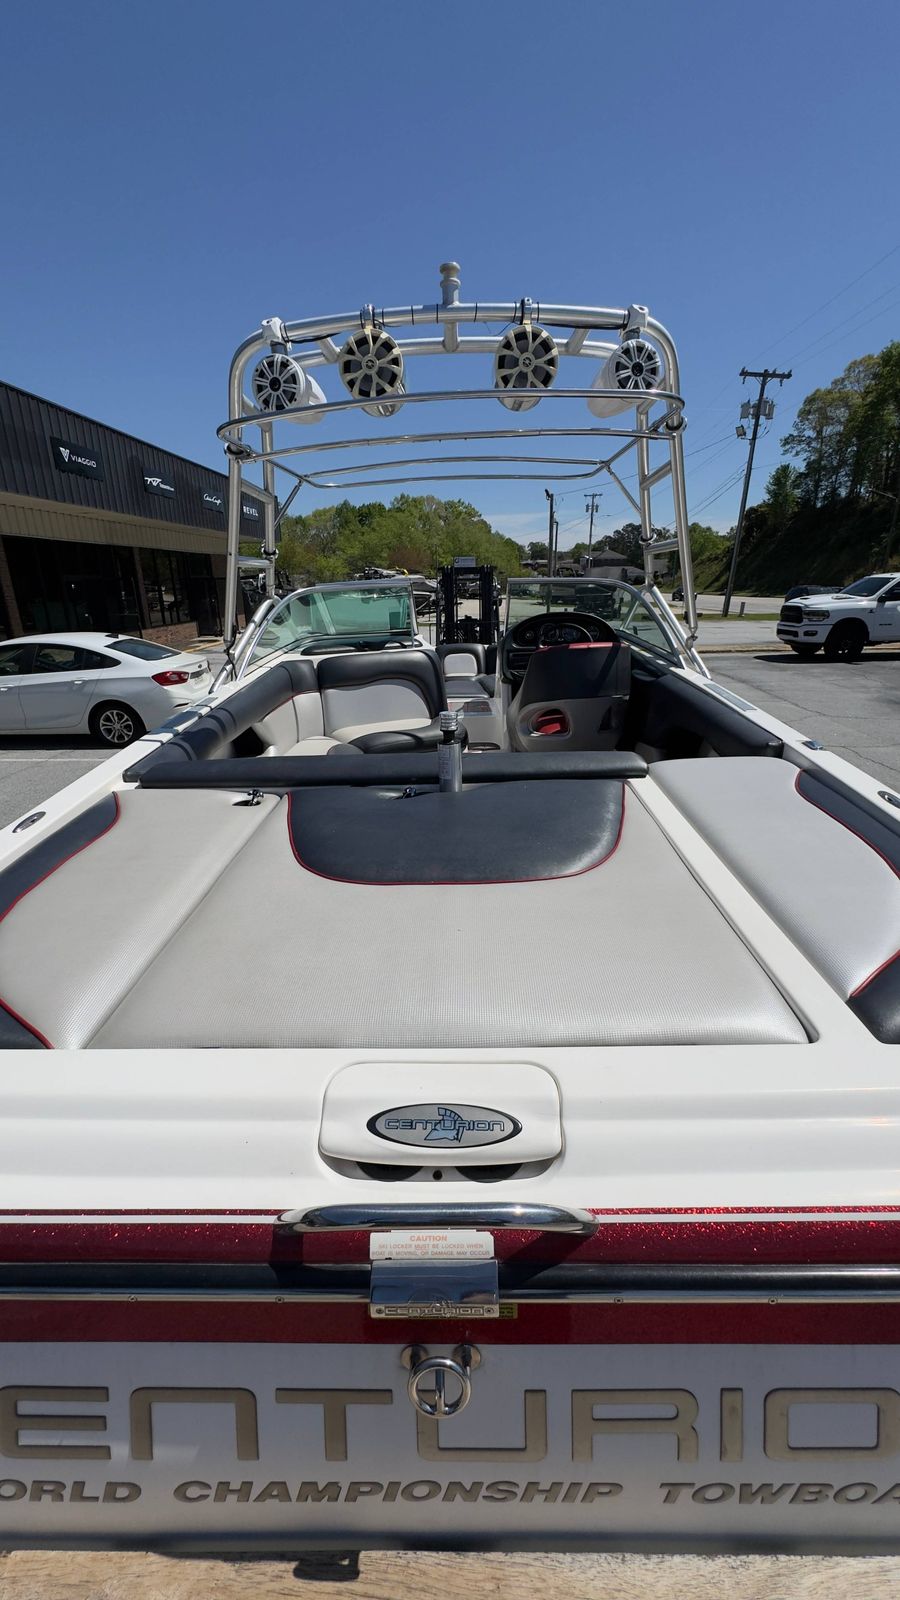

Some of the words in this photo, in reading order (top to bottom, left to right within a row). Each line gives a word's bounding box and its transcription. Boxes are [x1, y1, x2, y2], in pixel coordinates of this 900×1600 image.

[70, 455, 97, 468] VIAGGIO
[243, 505, 259, 517] REVEL
[385, 1119, 505, 1131] CENTURION
[409, 1234, 448, 1242] CAUTION
[385, 1306, 485, 1316] CENTURION
[173, 1480, 623, 1504] CHAMPIONSHIP
